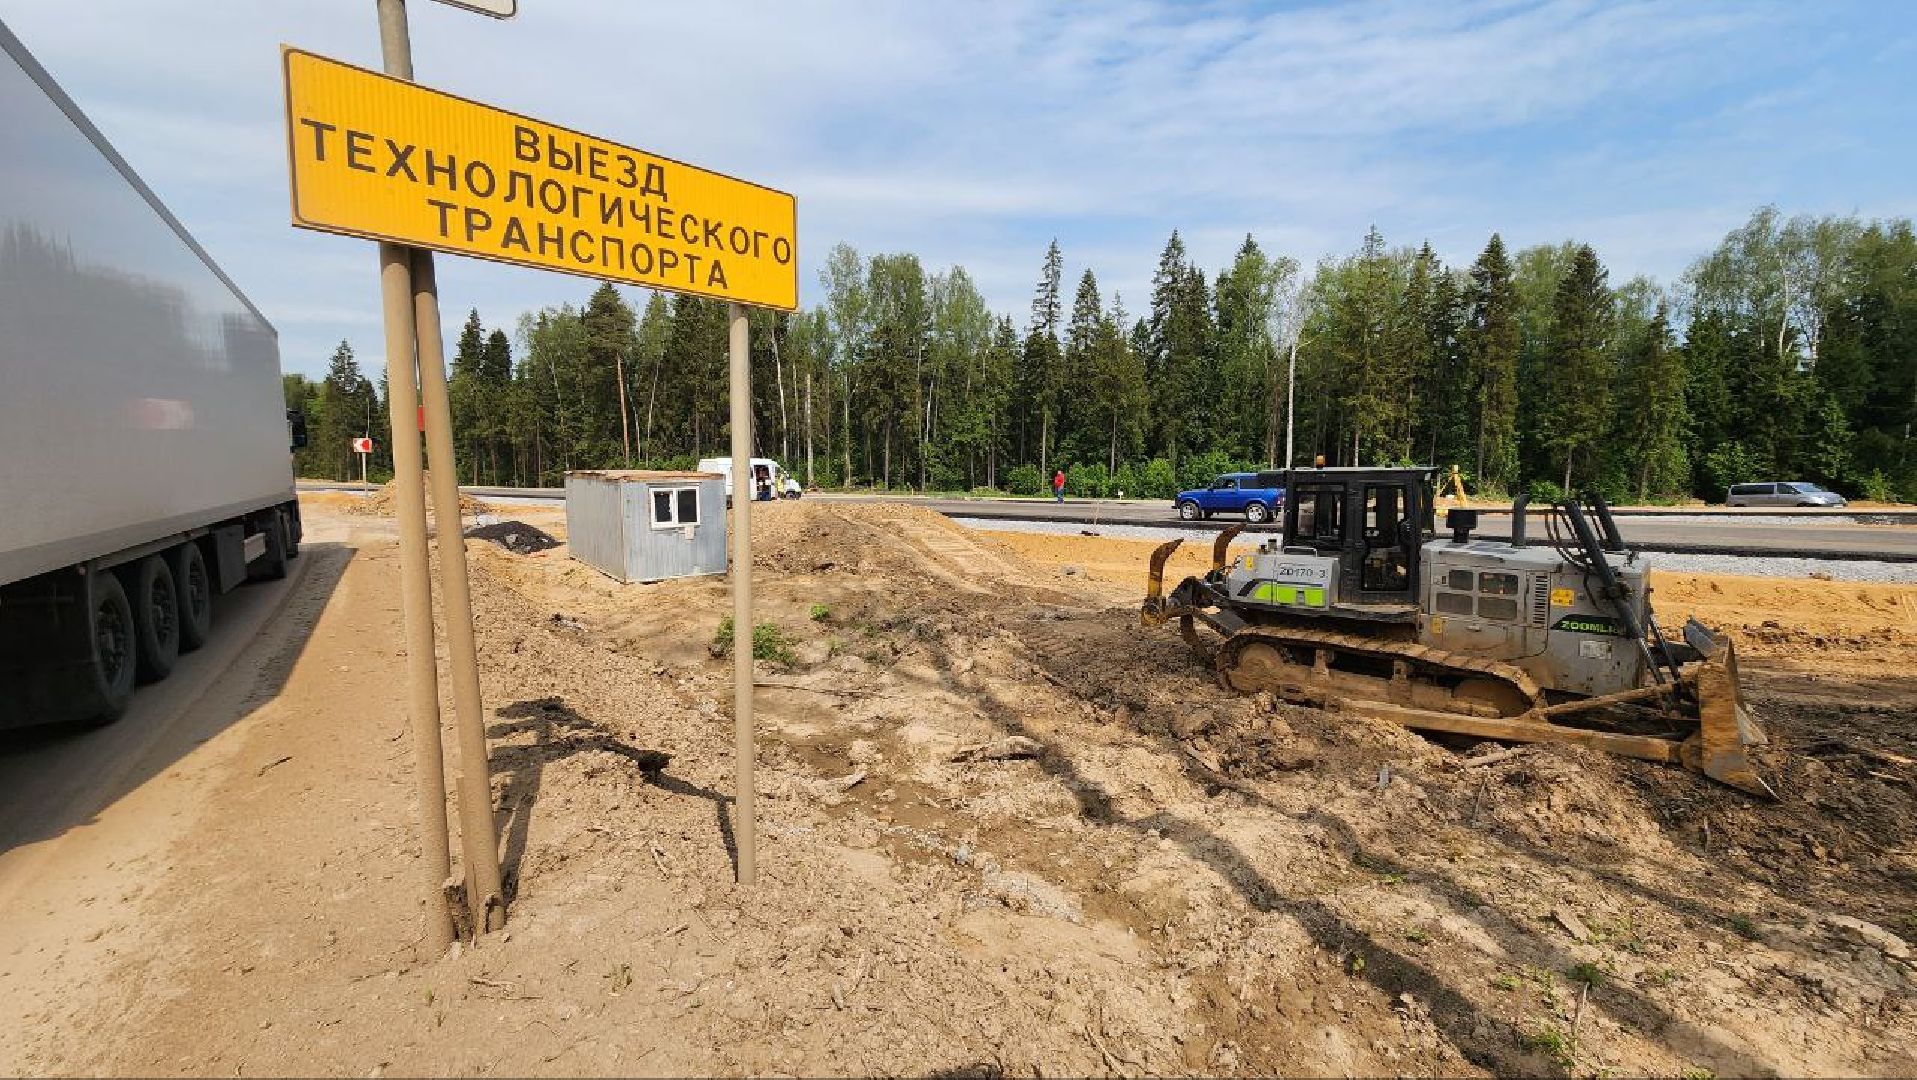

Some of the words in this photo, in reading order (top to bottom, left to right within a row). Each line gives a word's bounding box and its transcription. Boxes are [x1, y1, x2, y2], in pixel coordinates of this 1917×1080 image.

[300, 118, 791, 265] ТЕХНОЛОГИЧЕСКОГО
[514, 124, 667, 202] ВЫЕЗД
[427, 198, 728, 289] ТРАНСПОРТА
